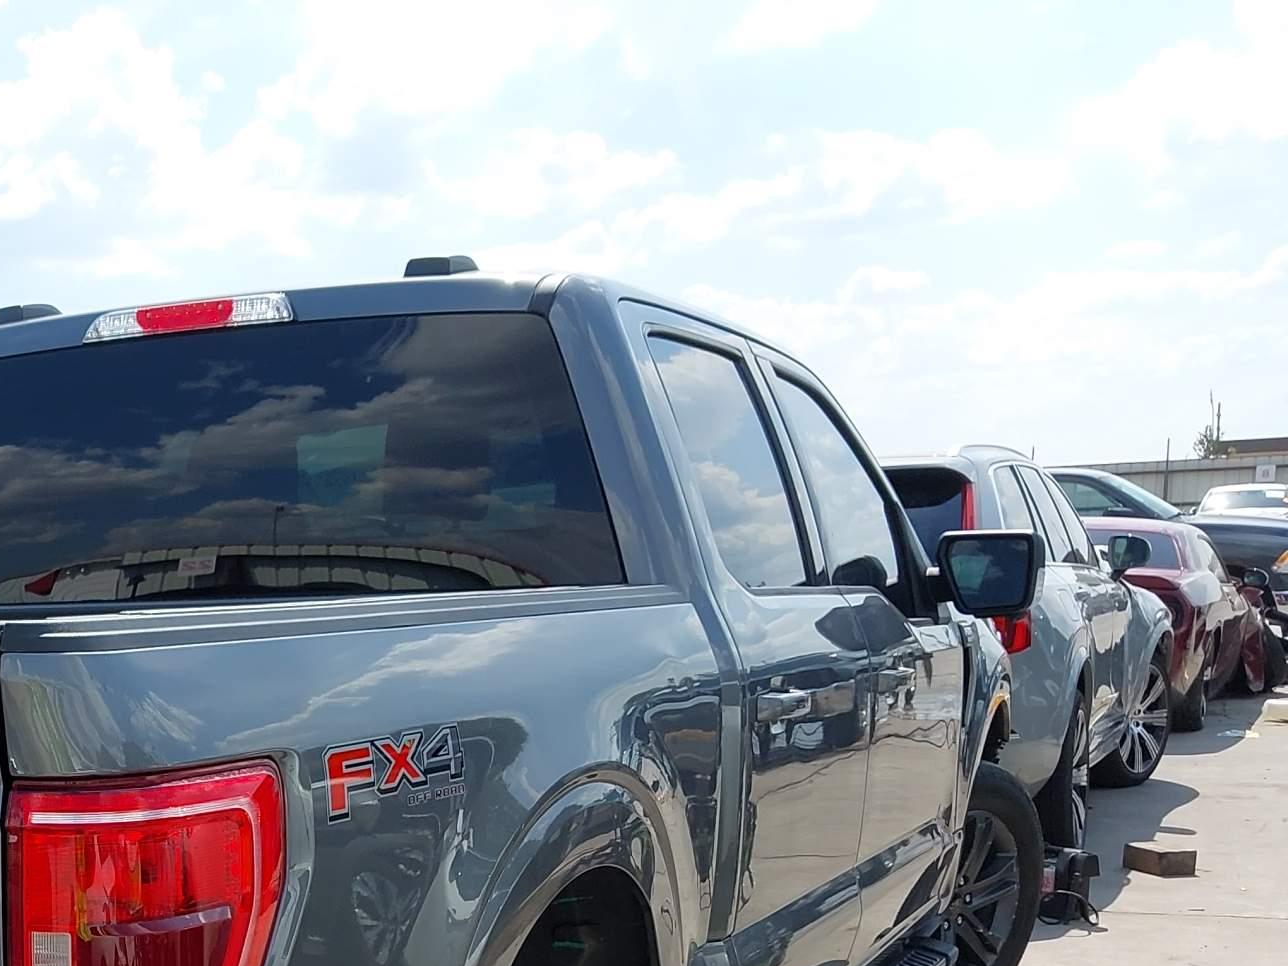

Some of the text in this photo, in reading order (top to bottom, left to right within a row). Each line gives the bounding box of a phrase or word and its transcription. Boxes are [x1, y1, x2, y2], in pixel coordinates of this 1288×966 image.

[322, 722, 465, 825] FX4
[407, 784, 466, 806] OFF ROAD
